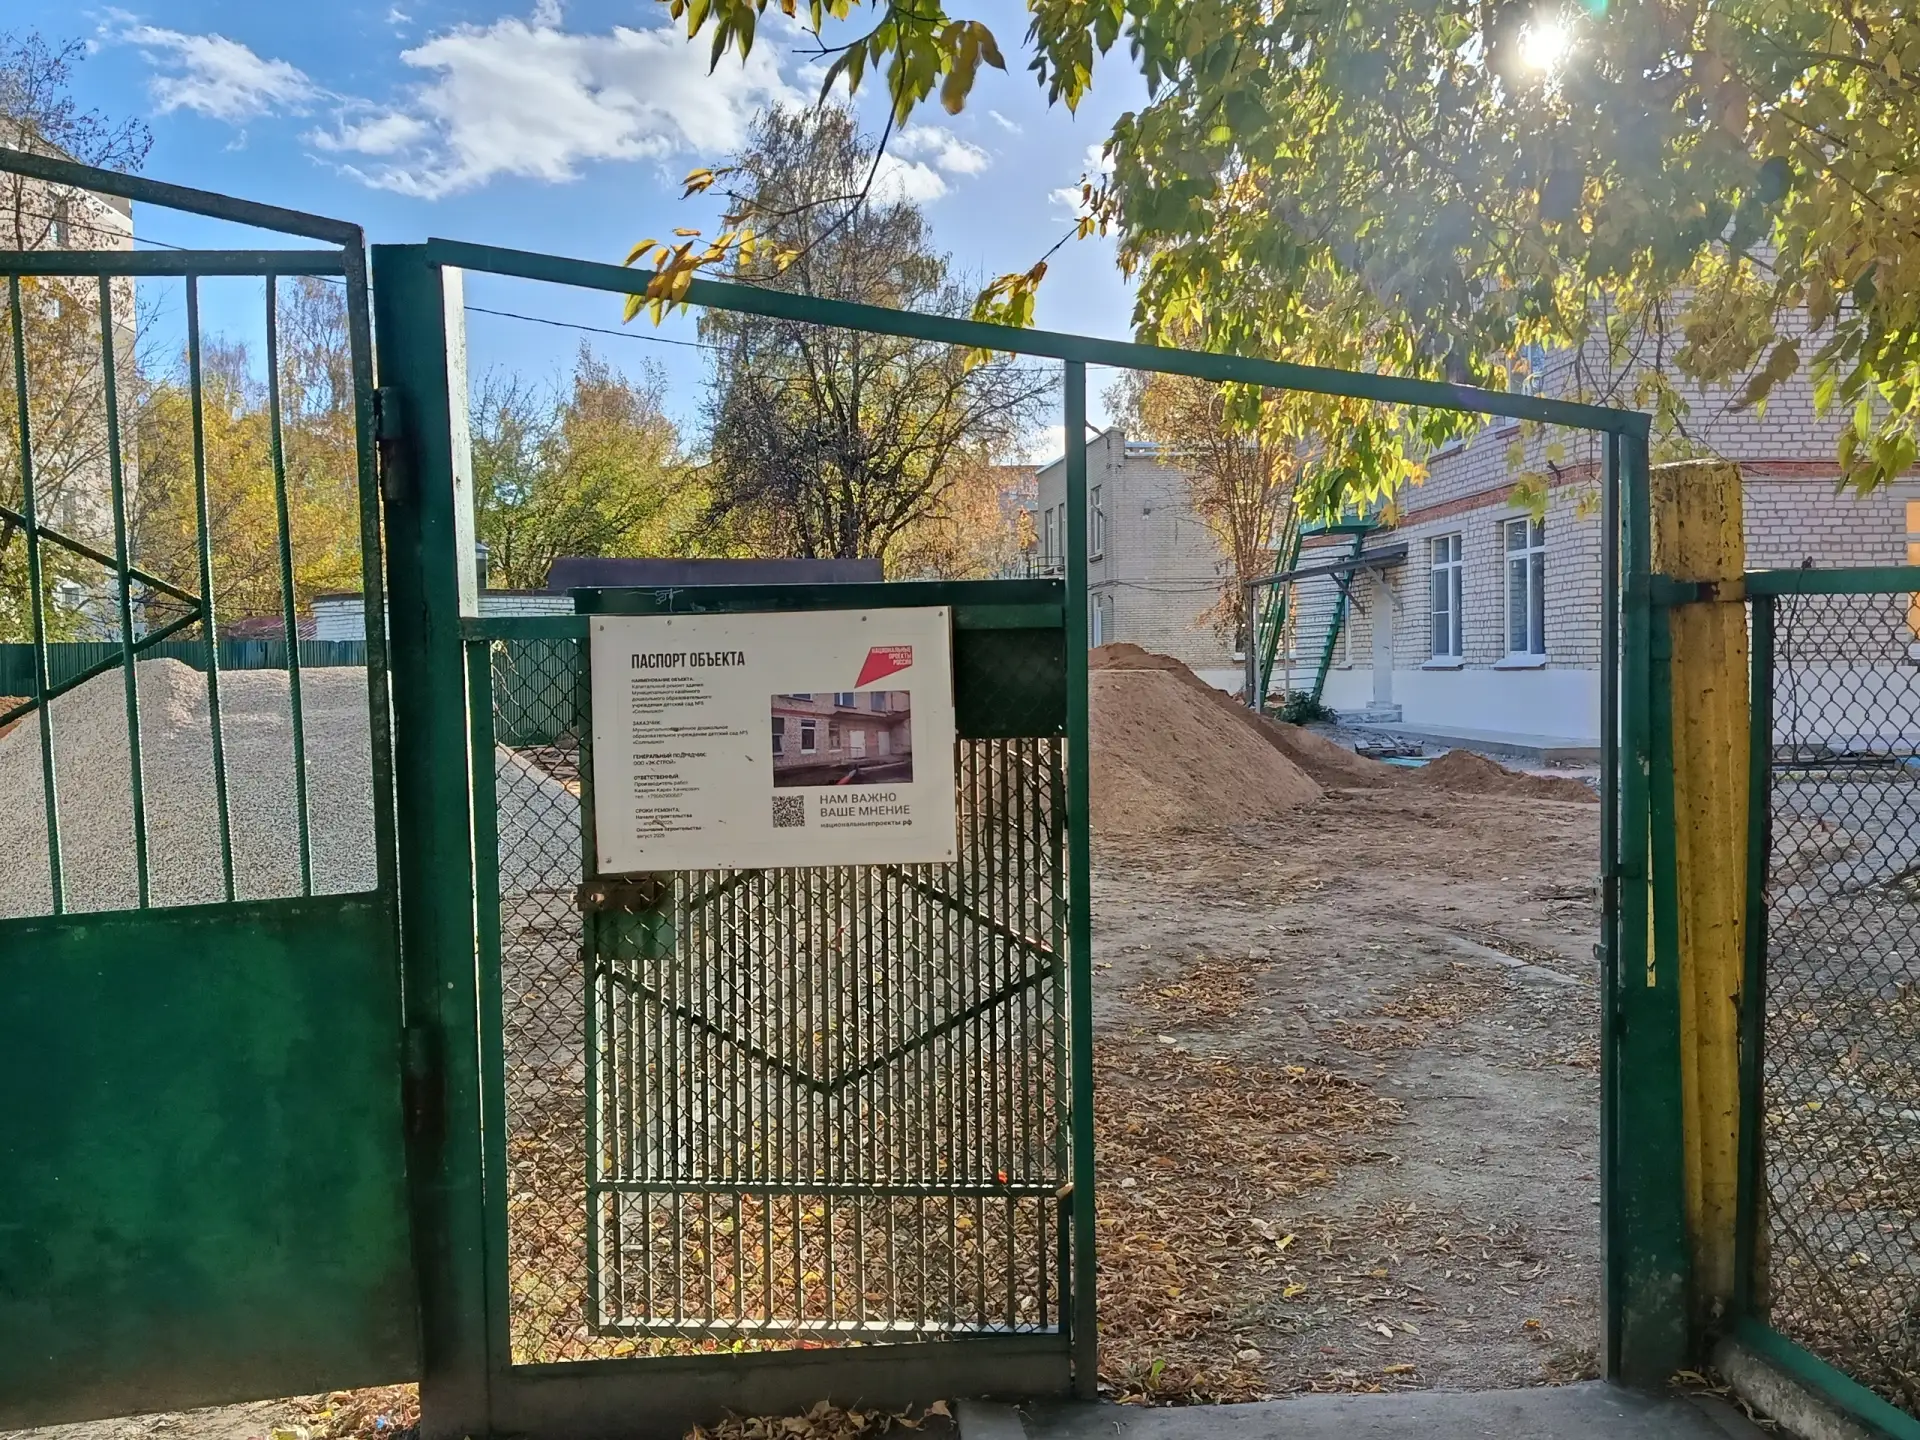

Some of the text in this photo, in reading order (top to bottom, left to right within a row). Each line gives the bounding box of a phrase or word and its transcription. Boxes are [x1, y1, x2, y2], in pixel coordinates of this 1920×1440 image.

[631, 651, 745, 669] ПАСПОРТ ОБЪЕКТА
[819, 792, 897, 804] НАМ ВАЖНО
[820, 805, 911, 817] ВАШЕ МНЕНИЕ
